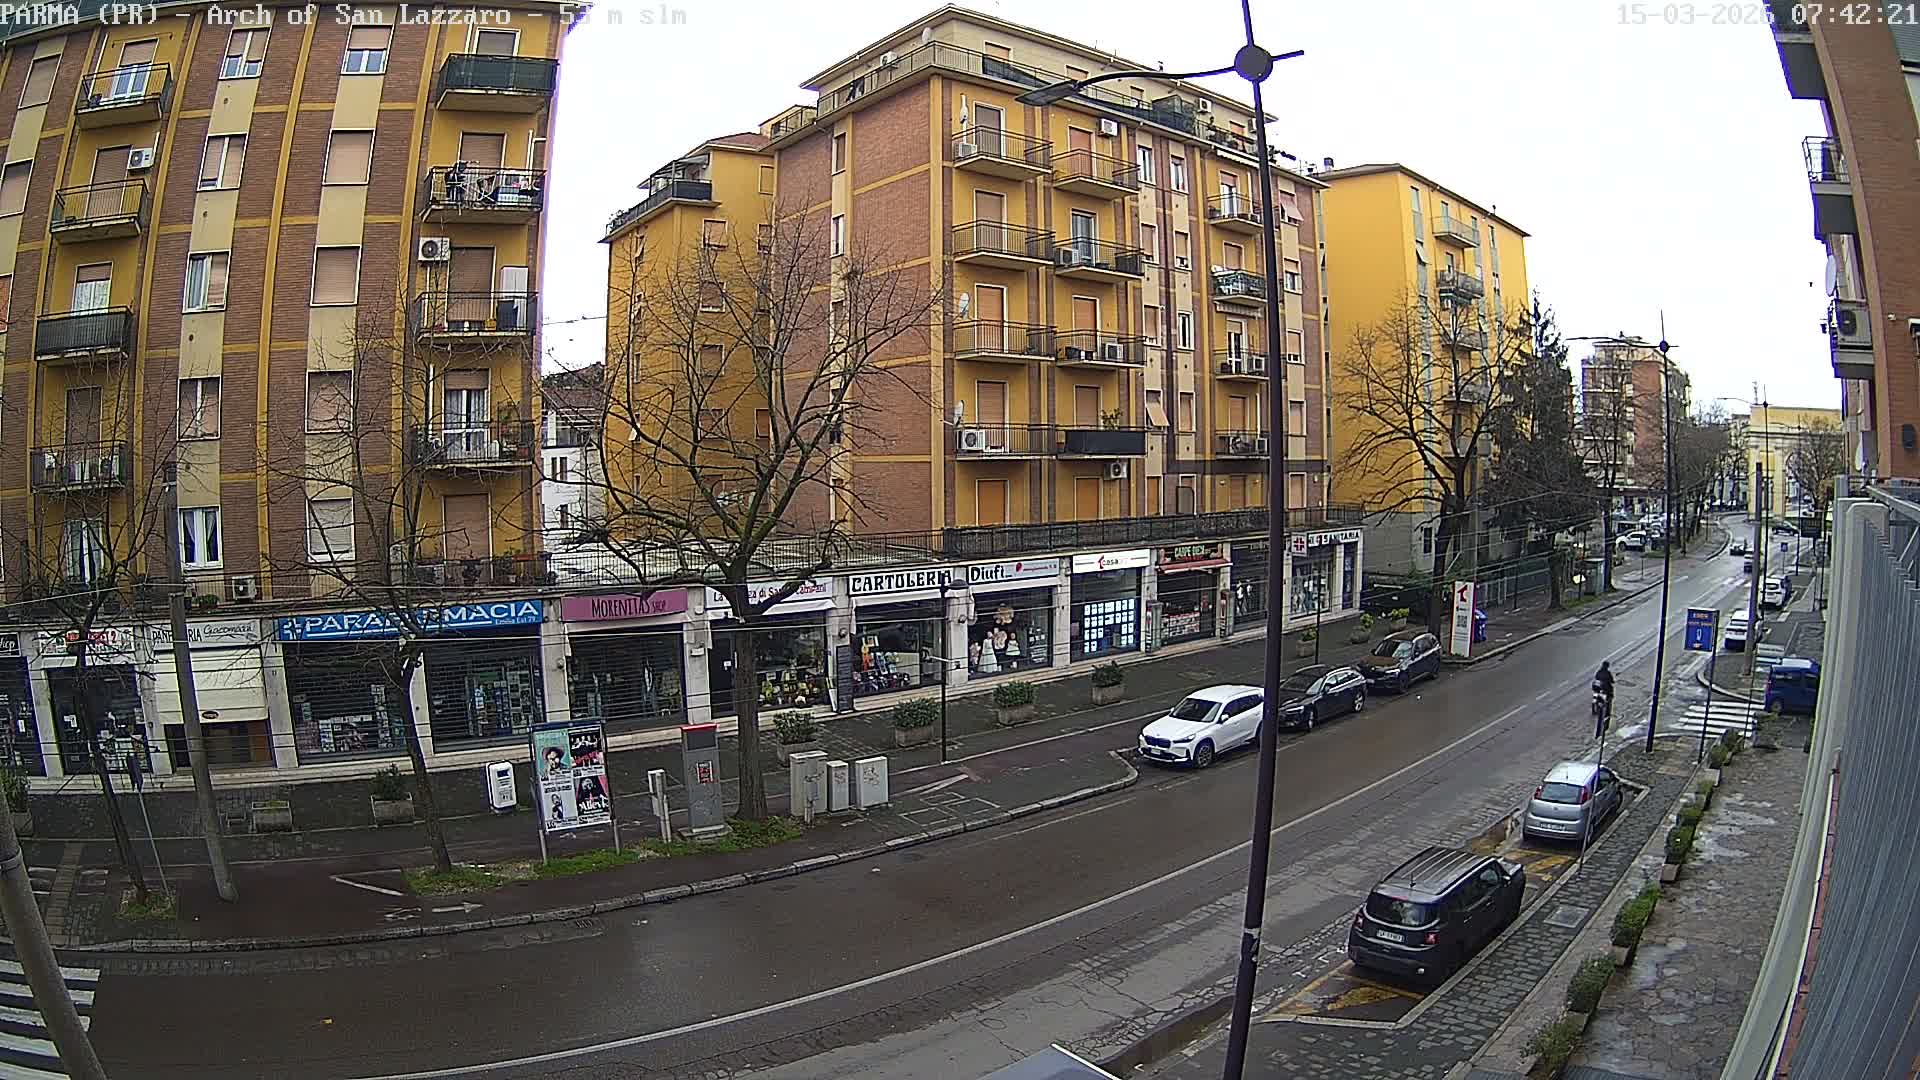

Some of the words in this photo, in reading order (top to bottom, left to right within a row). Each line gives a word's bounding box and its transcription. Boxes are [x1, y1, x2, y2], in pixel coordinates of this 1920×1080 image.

[852, 570, 952, 592] CARTOLERIA
[305, 602, 538, 632] PARAFRMACIA
[592, 597, 650, 618] MORENITAS
